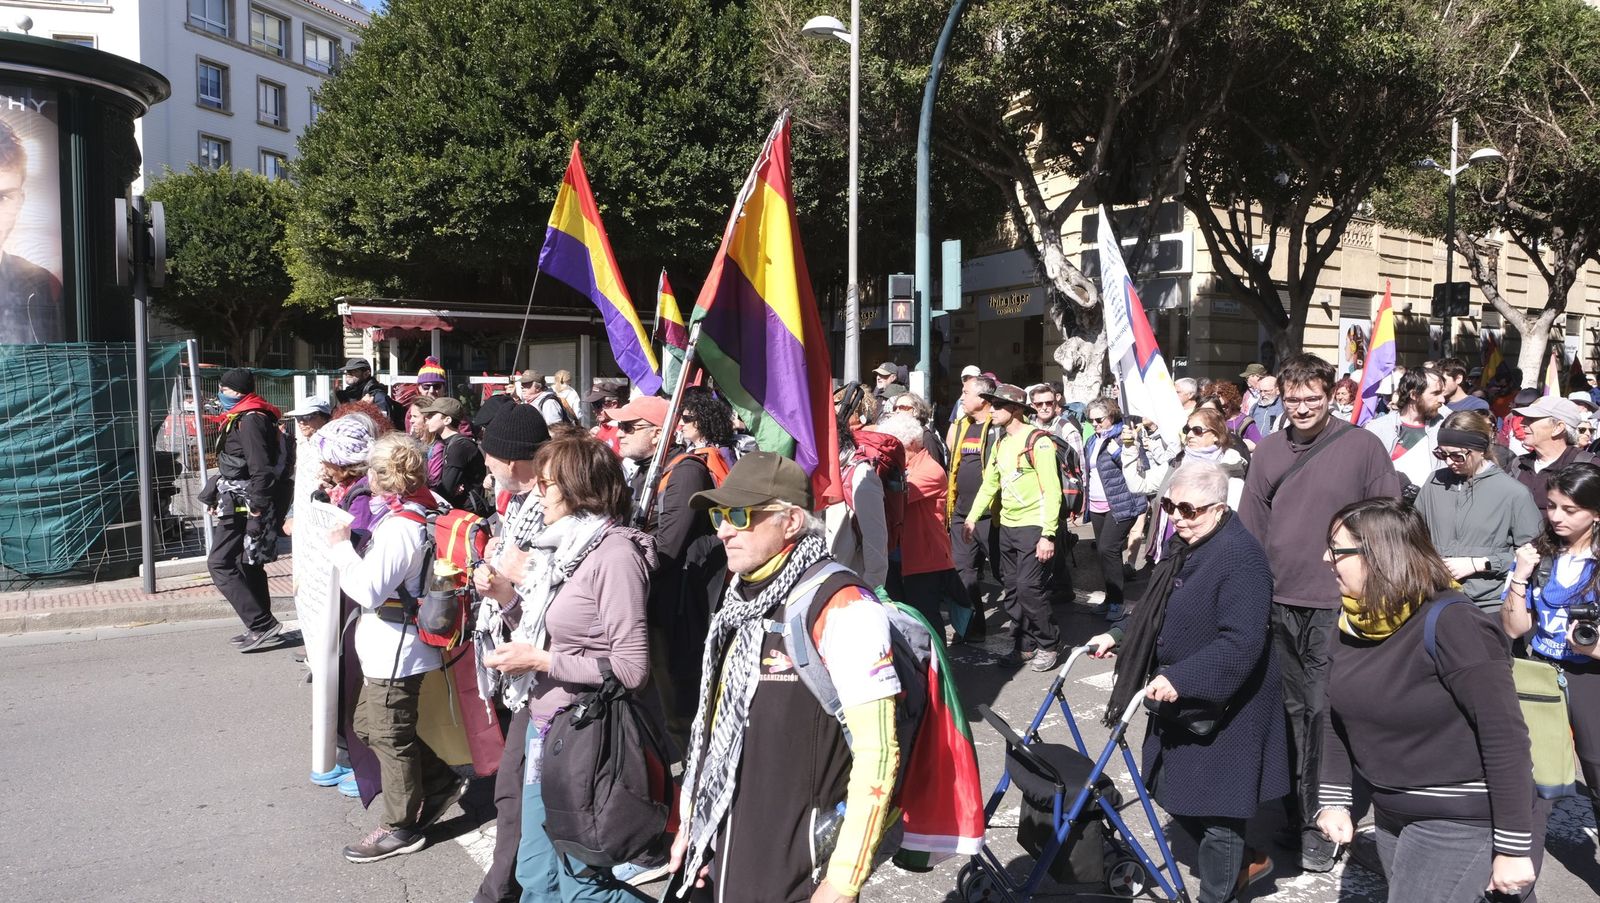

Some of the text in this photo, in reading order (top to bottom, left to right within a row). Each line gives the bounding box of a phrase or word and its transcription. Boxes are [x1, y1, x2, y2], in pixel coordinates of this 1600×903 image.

[0, 95, 47, 113] HY
[988, 292, 1030, 309] flying tiger
[760, 673, 798, 681] RGANIZACIÓN
